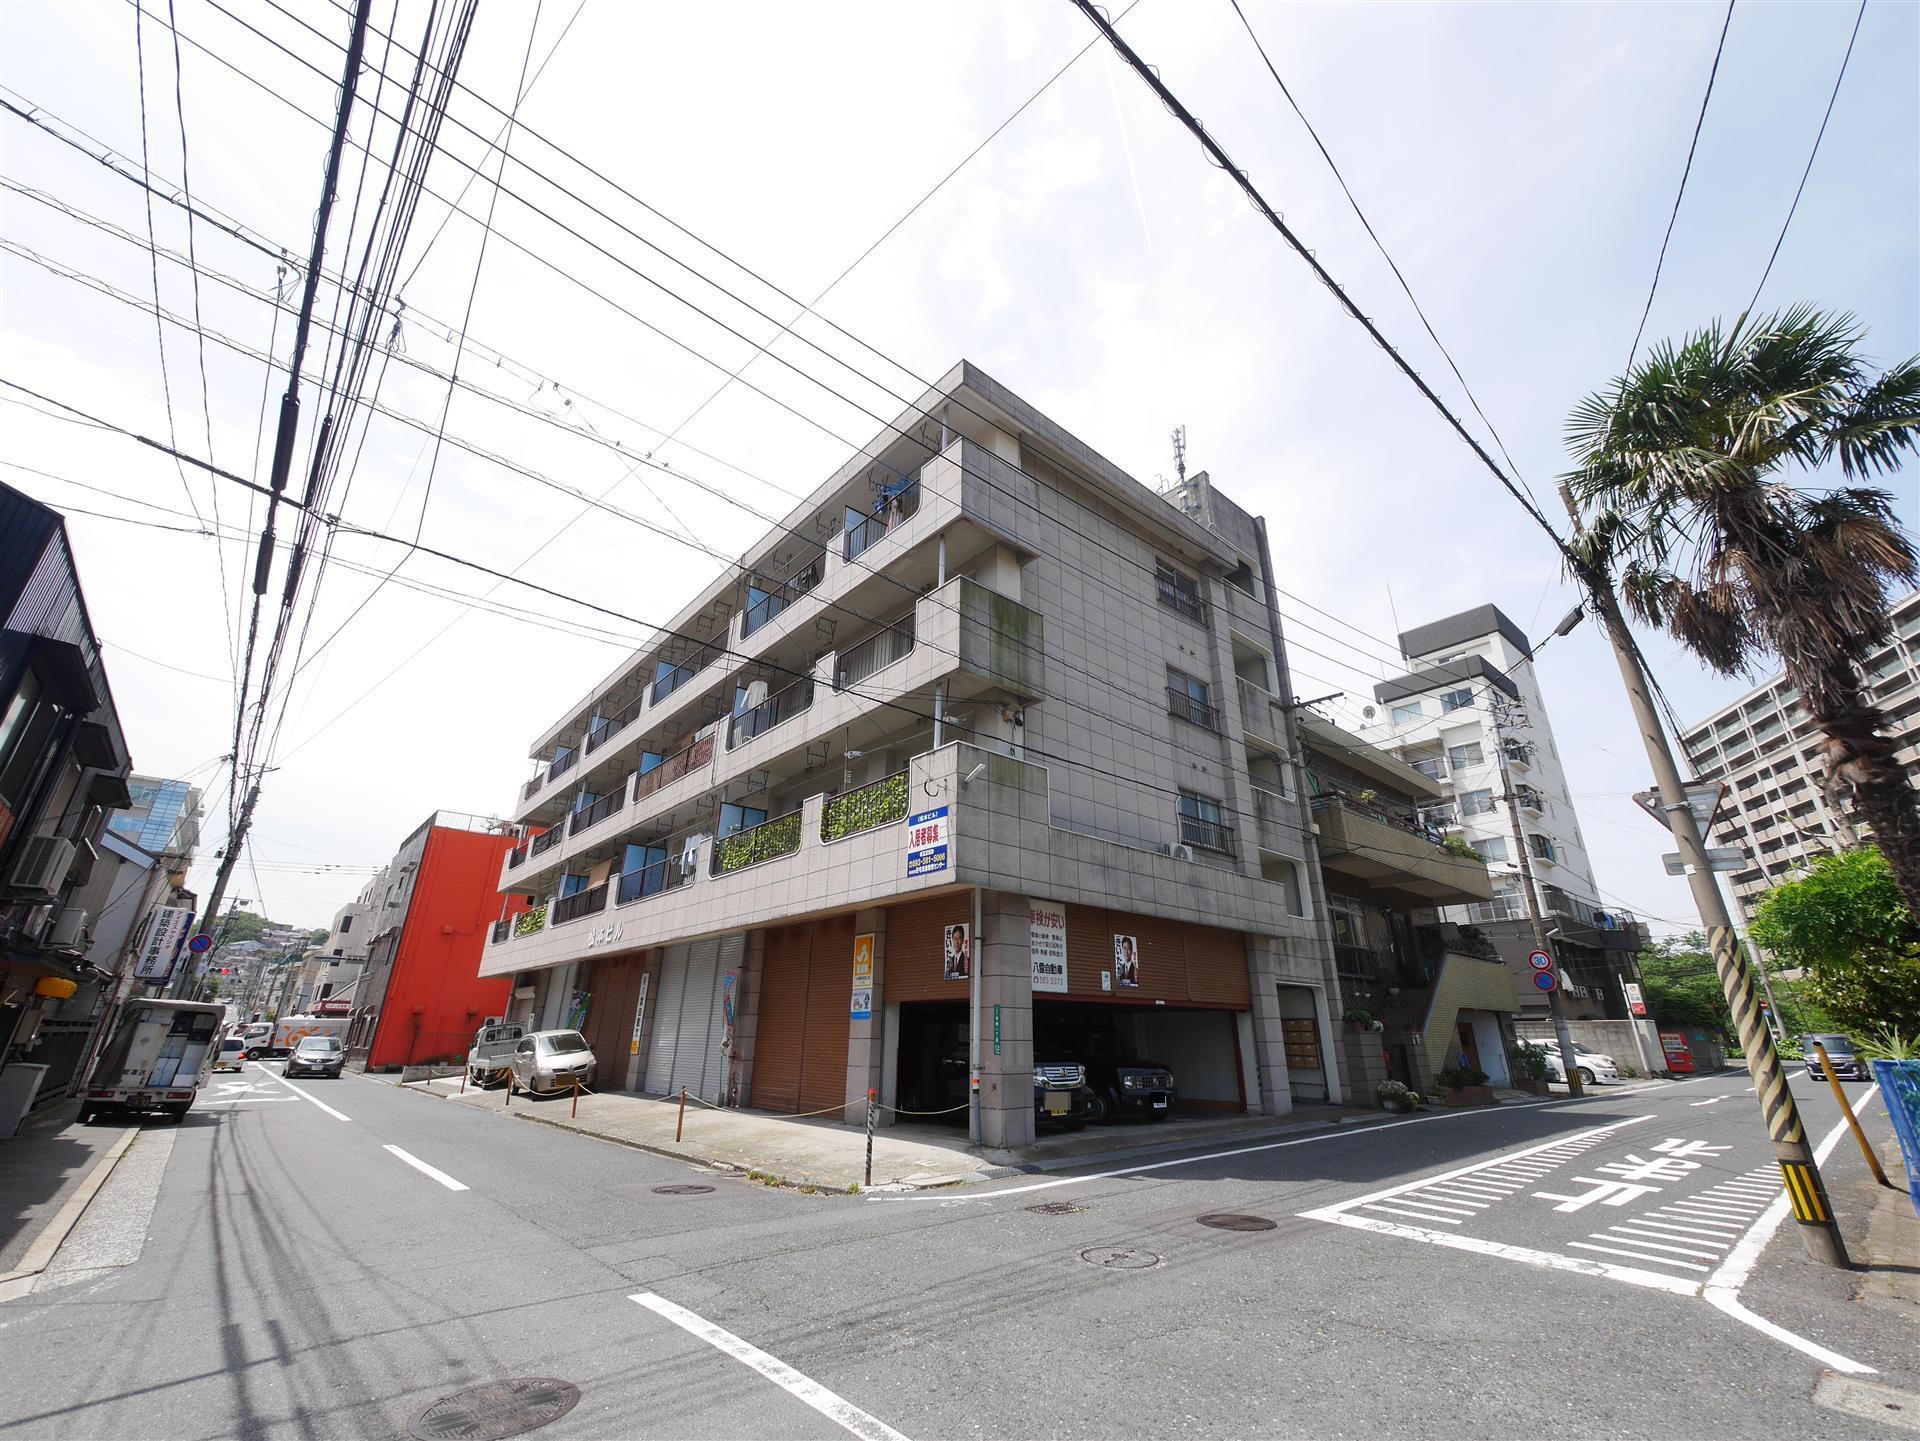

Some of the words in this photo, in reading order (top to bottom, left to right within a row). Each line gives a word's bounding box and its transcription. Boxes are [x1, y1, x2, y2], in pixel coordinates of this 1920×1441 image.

[140, 909, 175, 975] 建築設計事務所
[1533, 956, 1546, 966] 30
[1530, 1137, 1735, 1213] 止まれ
